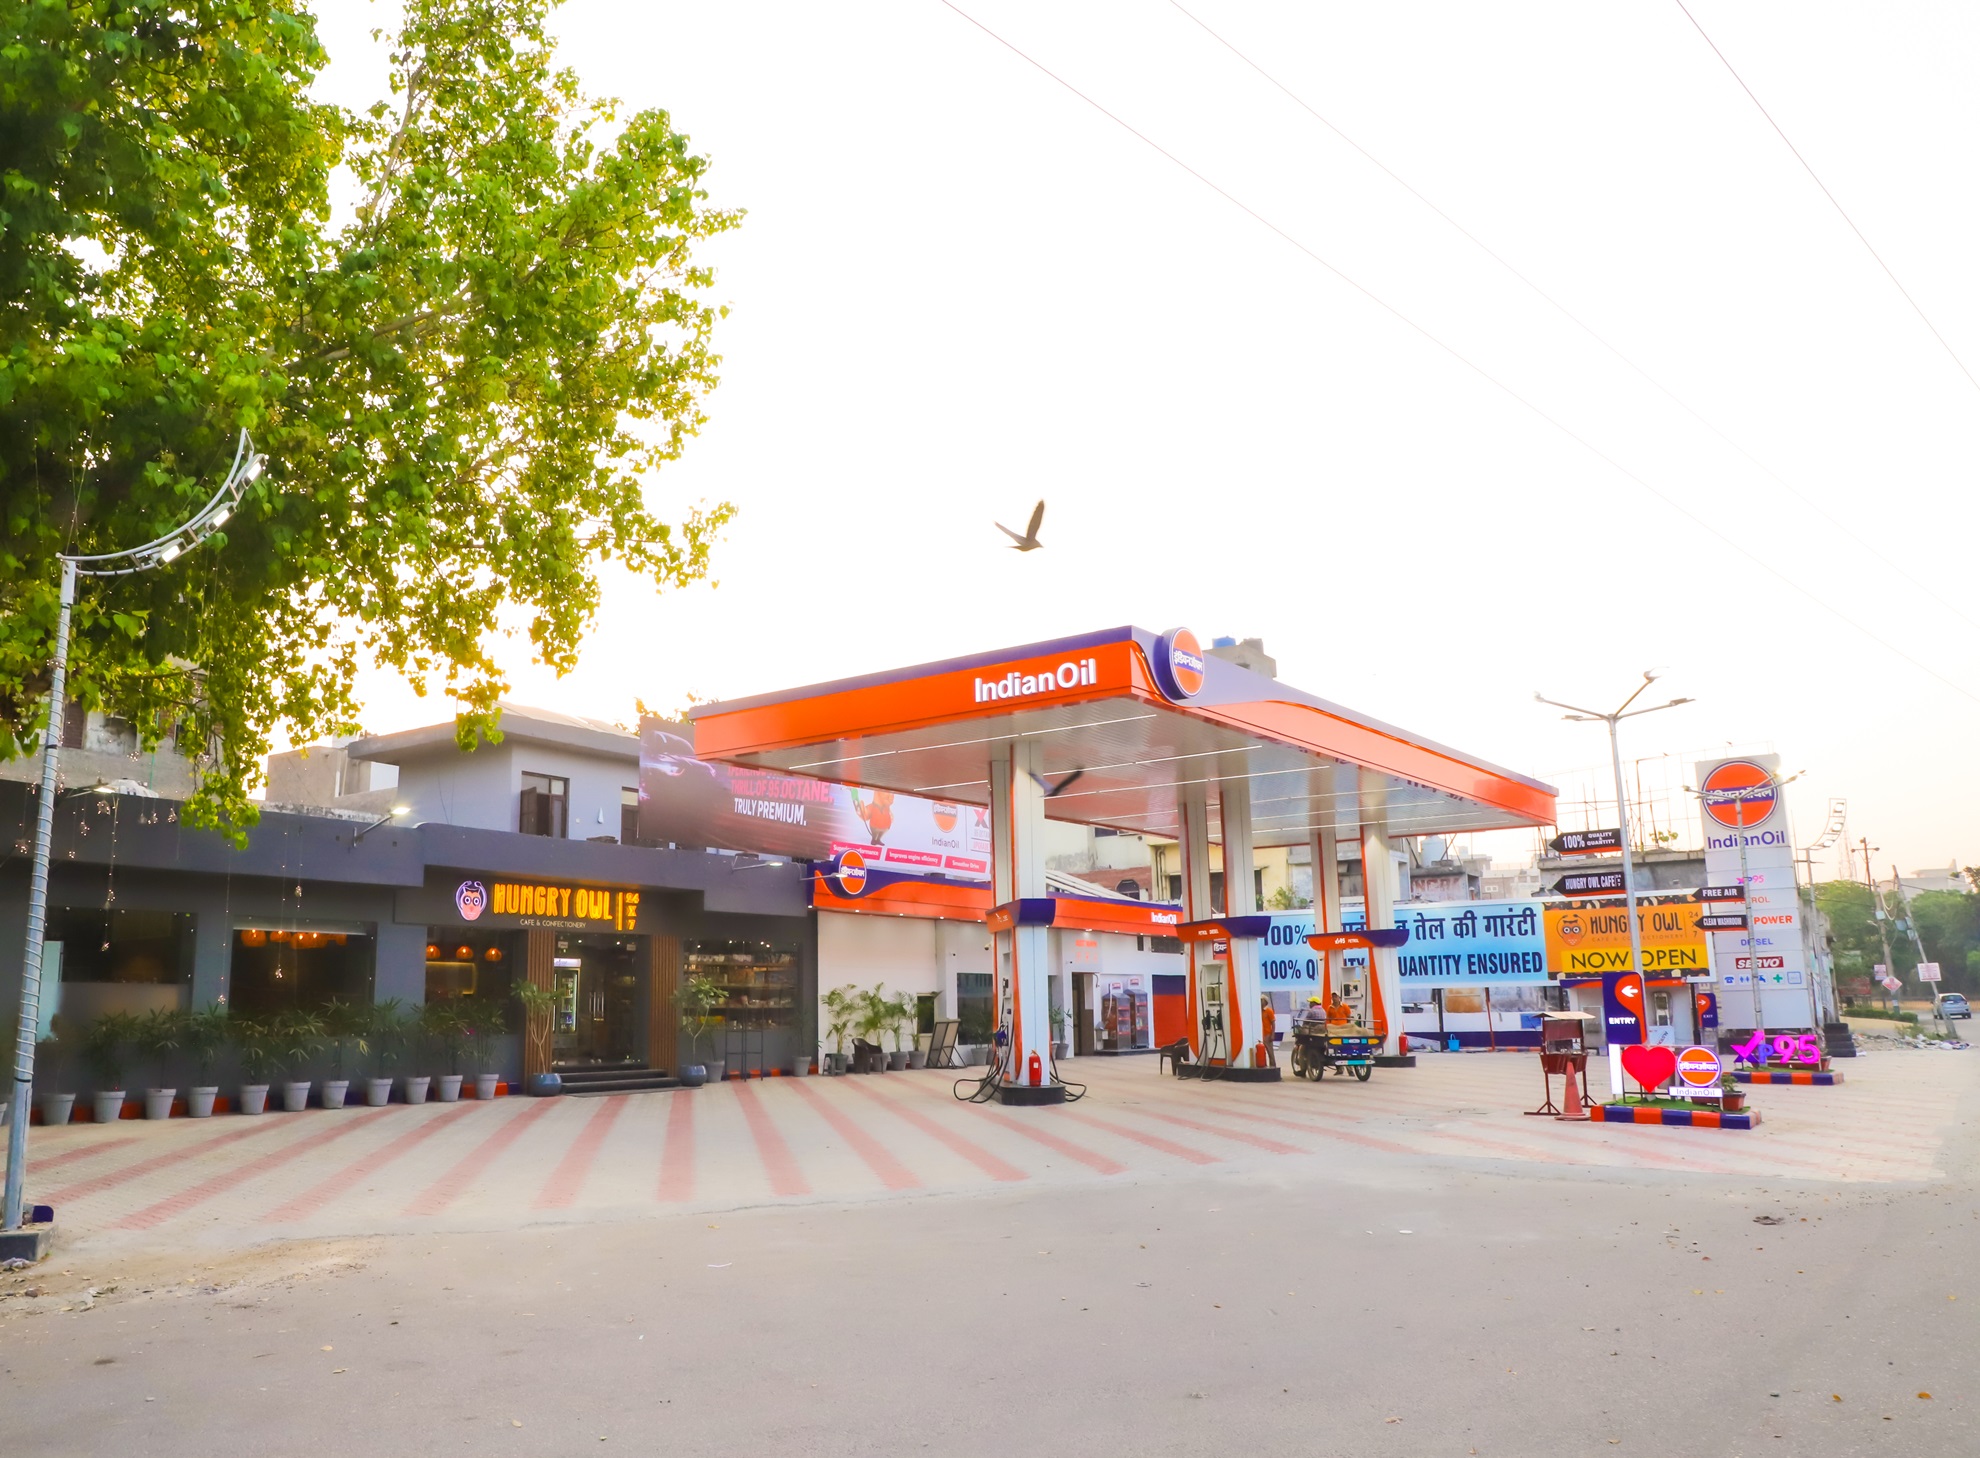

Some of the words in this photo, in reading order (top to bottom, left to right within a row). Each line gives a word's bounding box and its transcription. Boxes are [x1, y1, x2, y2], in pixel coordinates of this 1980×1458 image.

[974, 658, 1097, 702] IndianOil
[731, 780, 755, 796] THRILL
[755, 782, 767, 797] OF
[768, 782, 780, 798] 95
[734, 798, 756, 816] TRULY
[757, 800, 807, 826] PREMIUM.
[931, 837, 960, 849] IndianOil
[1562, 834, 1585, 849] 100%
[1586, 838, 1616, 846] QUANTITY
[1565, 876, 1587, 890] HUNGRY
[1588, 876, 1600, 888] OWL
[1600, 875, 1615, 888] CAFE
[1702, 889, 1722, 897] FREE
[1724, 888, 1738, 896] AIR
[494, 884, 572, 917] HUNGRY
[575, 889, 613, 920] OWL
[520, 918, 535, 926] CAFE
[536, 919, 541, 927] &
[542, 919, 587, 929] CONFECTIONERY
[1151, 912, 1178, 924] IndianOil
[1413, 912, 1446, 941] तेल
[1451, 909, 1478, 939] की
[1482, 906, 1537, 938] गारंटी
[1590, 913, 1645, 935] HUNGY
[1652, 911, 1683, 932] OWL
[1703, 918, 1717, 926] CLEAN
[1754, 915, 1793, 925] POWER
[1693, 930, 1698, 938] 7
[1398, 954, 1462, 977] UANTITY
[1467, 951, 1543, 975] ENSURED
[1571, 951, 1630, 969] NOW
[1641, 949, 1697, 967] OPEN
[1261, 959, 1302, 980] 100%
[1608, 1016, 1636, 1025] ENTRY
[1676, 1087, 1716, 1096] IndianOil
